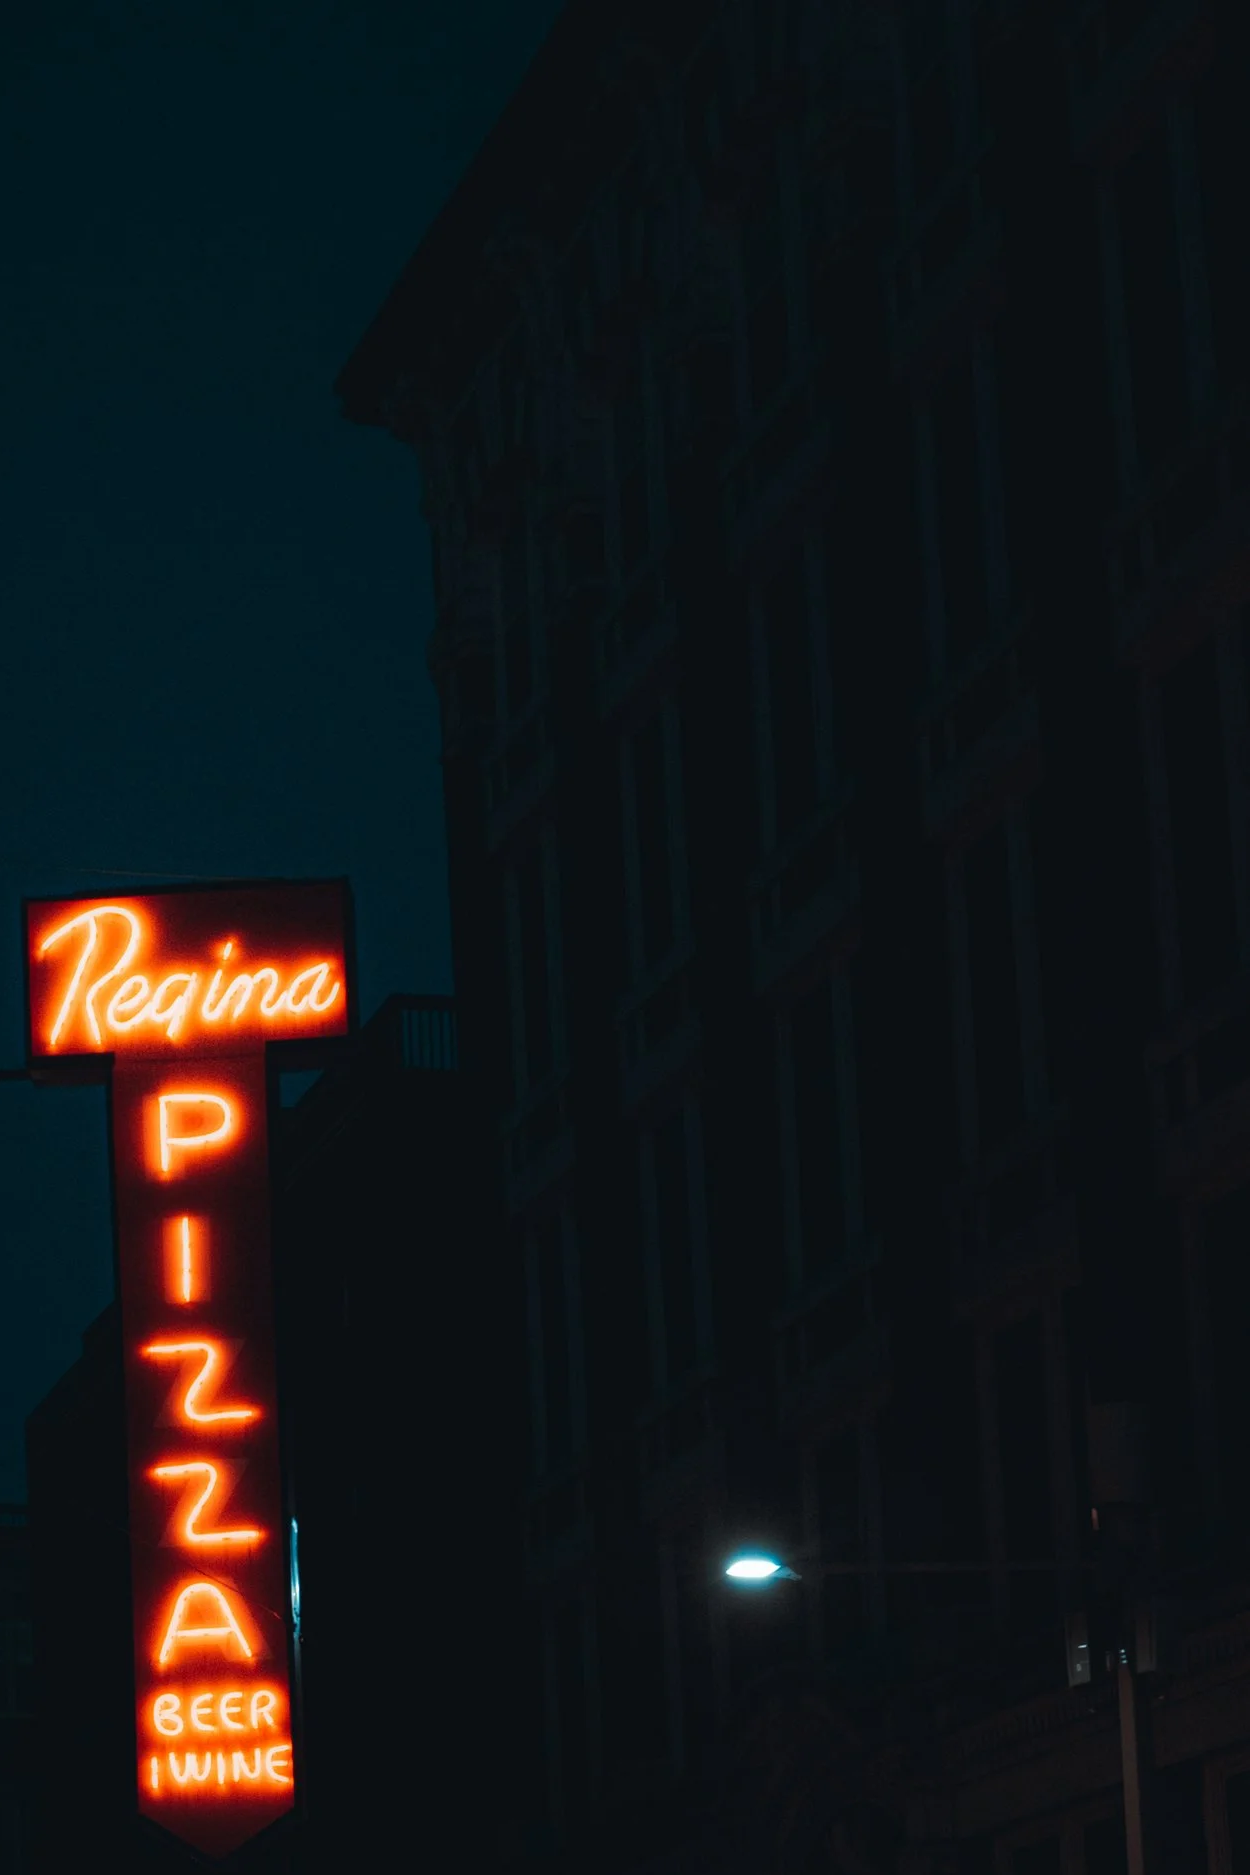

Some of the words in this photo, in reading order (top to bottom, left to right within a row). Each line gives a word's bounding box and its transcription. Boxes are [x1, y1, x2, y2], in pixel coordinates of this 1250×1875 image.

[40, 905, 341, 1046] Regina
[147, 1093, 262, 1664] PIZZA
[153, 1690, 276, 1736] BEER
[168, 1745, 291, 1785] WINE
